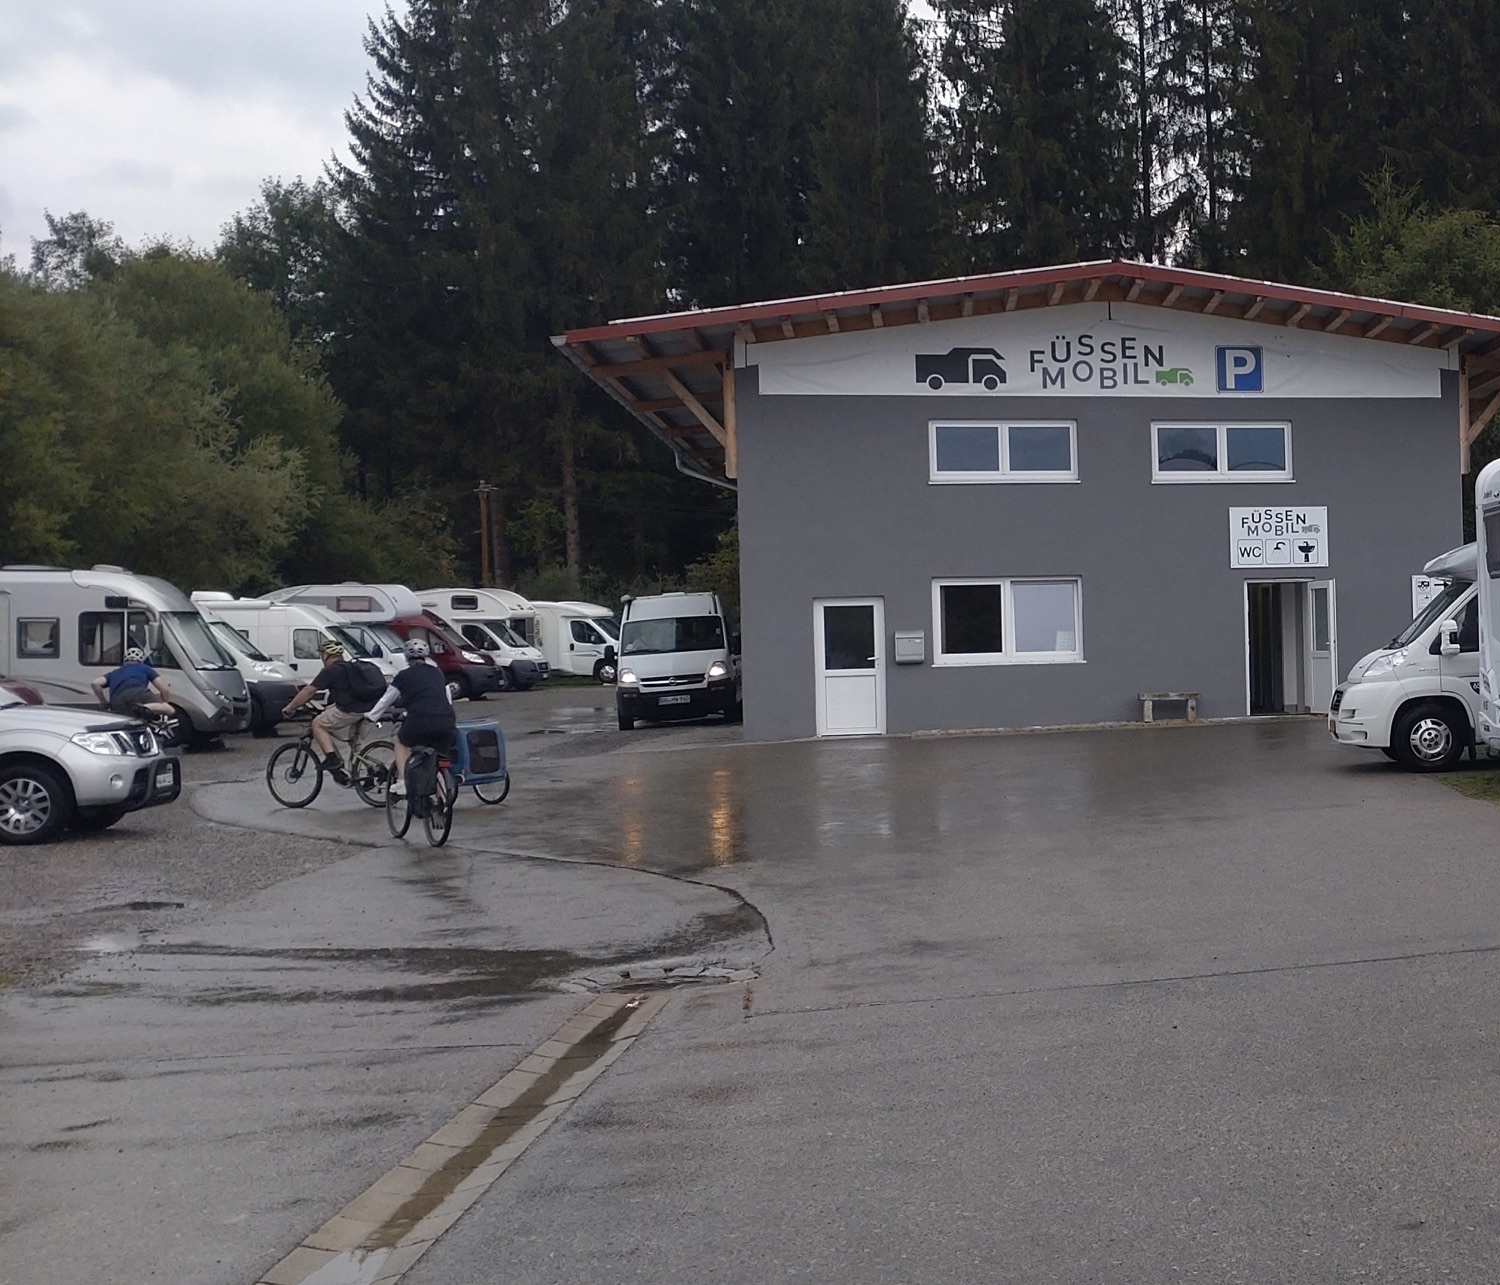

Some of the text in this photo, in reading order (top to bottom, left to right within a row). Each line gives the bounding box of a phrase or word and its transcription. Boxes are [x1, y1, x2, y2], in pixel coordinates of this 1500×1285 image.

[1029, 334, 1164, 372] FÜSSEN
[1042, 360, 1150, 390] MOBIL
[1225, 349, 1256, 389] P
[1241, 509, 1306, 529] FÜSSEN
[1247, 522, 1299, 537] MOBIL
[1239, 546, 1262, 558] WC
